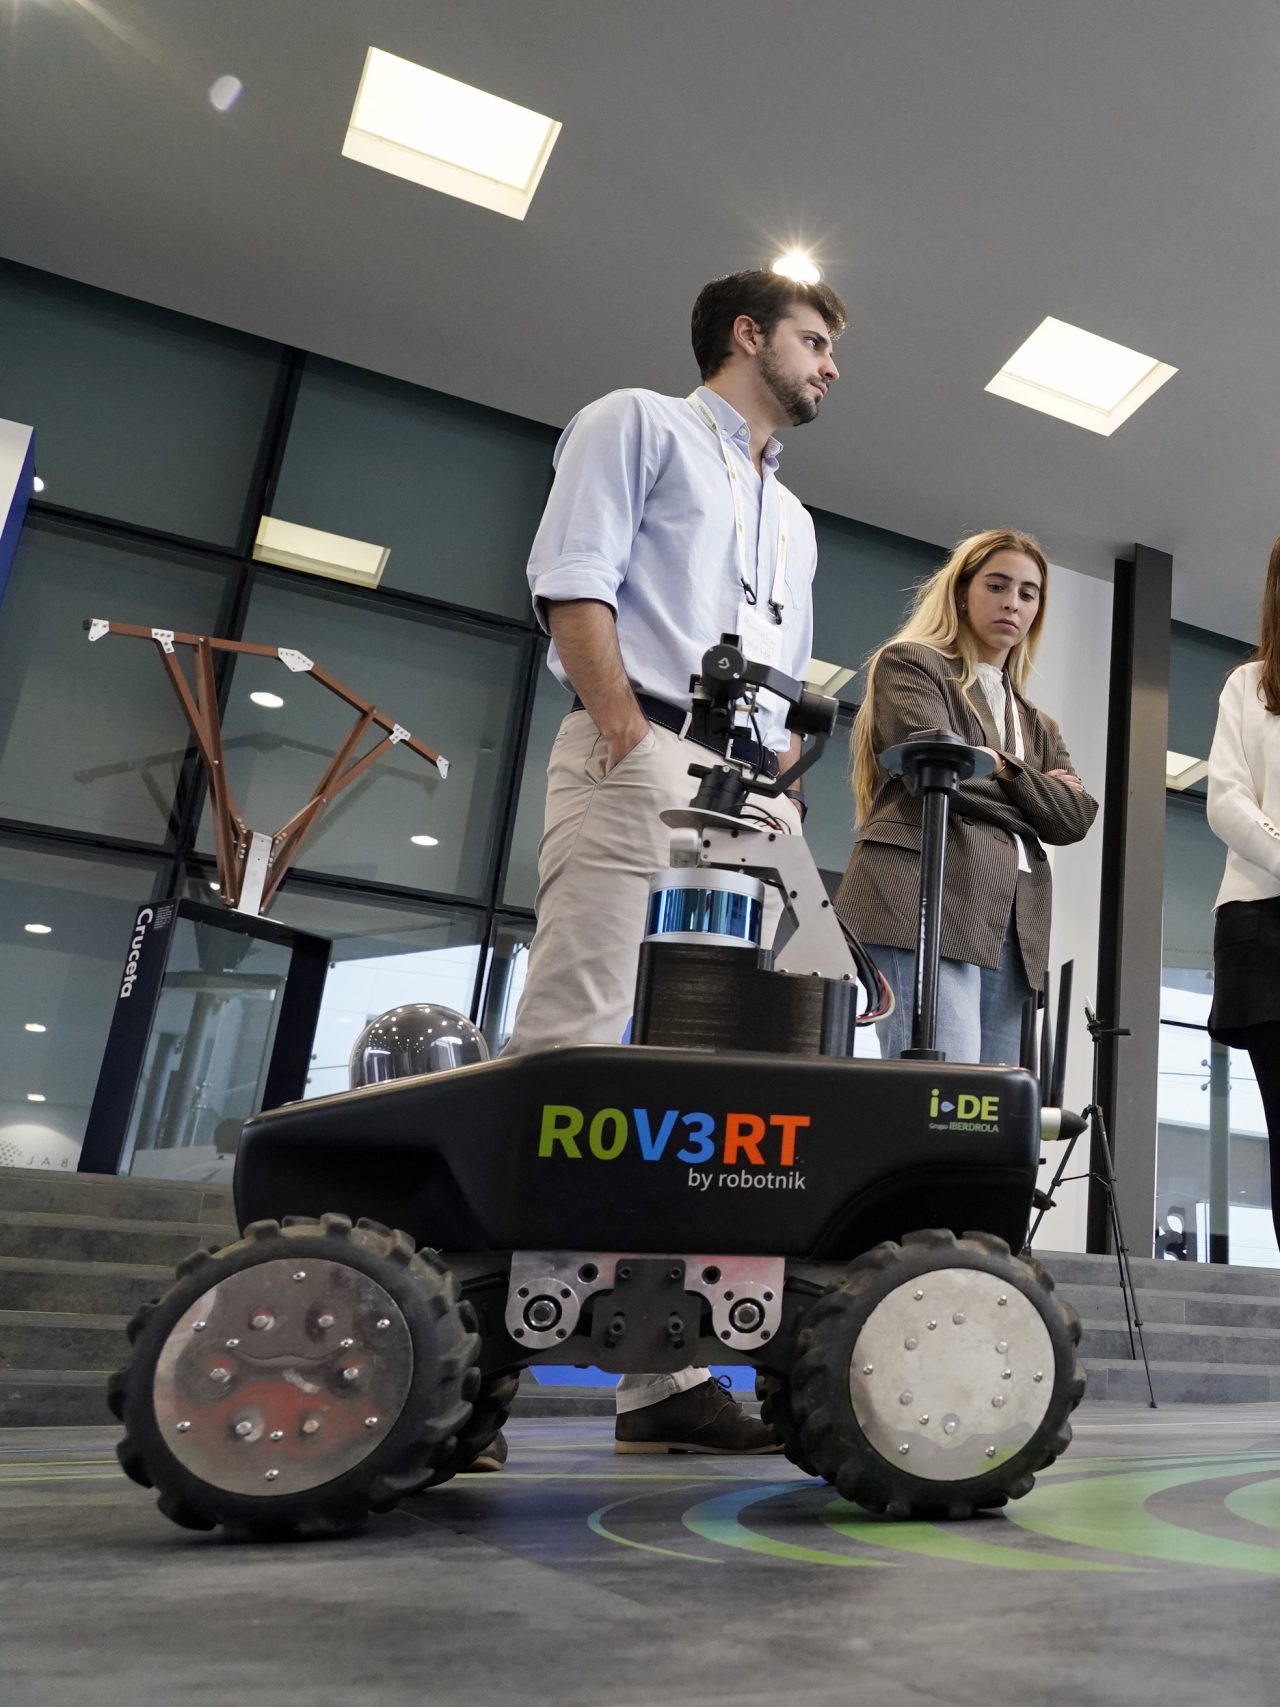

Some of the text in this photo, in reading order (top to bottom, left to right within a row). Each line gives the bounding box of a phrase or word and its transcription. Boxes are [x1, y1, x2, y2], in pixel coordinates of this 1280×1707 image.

[120, 907, 154, 999] Cruceta
[949, 1121, 1000, 1133] IBERDROLA
[687, 1167, 807, 1191] by robotnik
